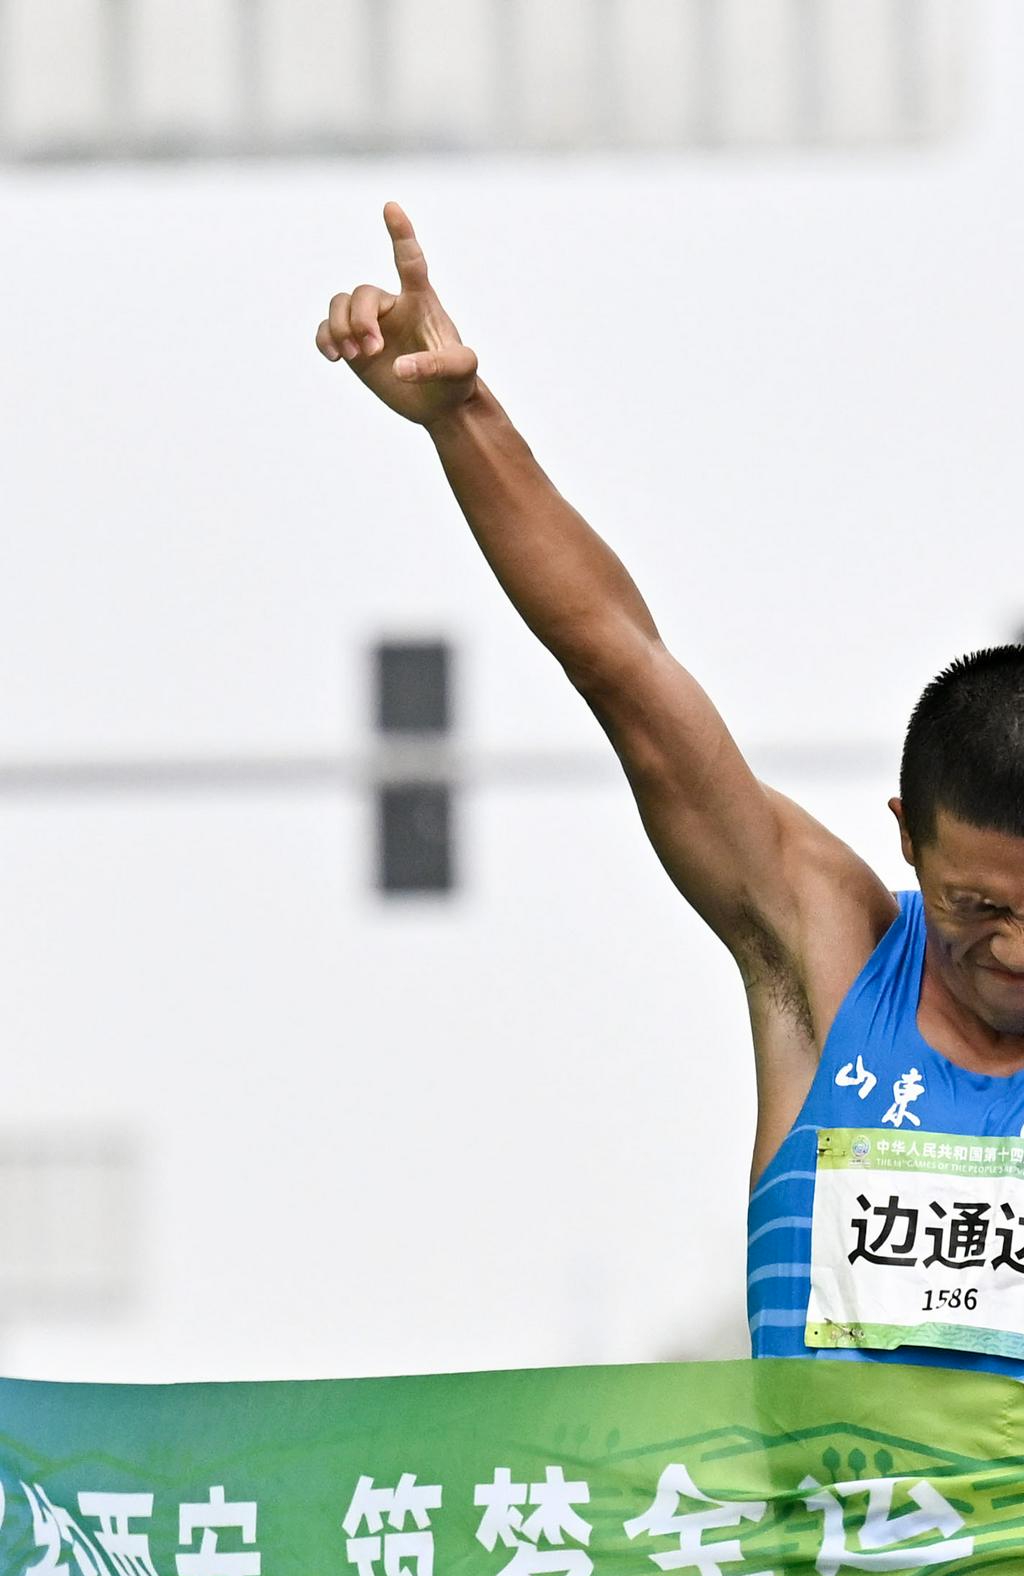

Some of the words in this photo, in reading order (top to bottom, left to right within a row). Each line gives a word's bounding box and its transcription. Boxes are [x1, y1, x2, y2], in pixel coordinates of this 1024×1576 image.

[876, 1159, 892, 1167] THE
[907, 1160, 936, 1169] GAMES
[937, 1162, 949, 1170] OF
[922, 1288, 978, 1310] 1586
